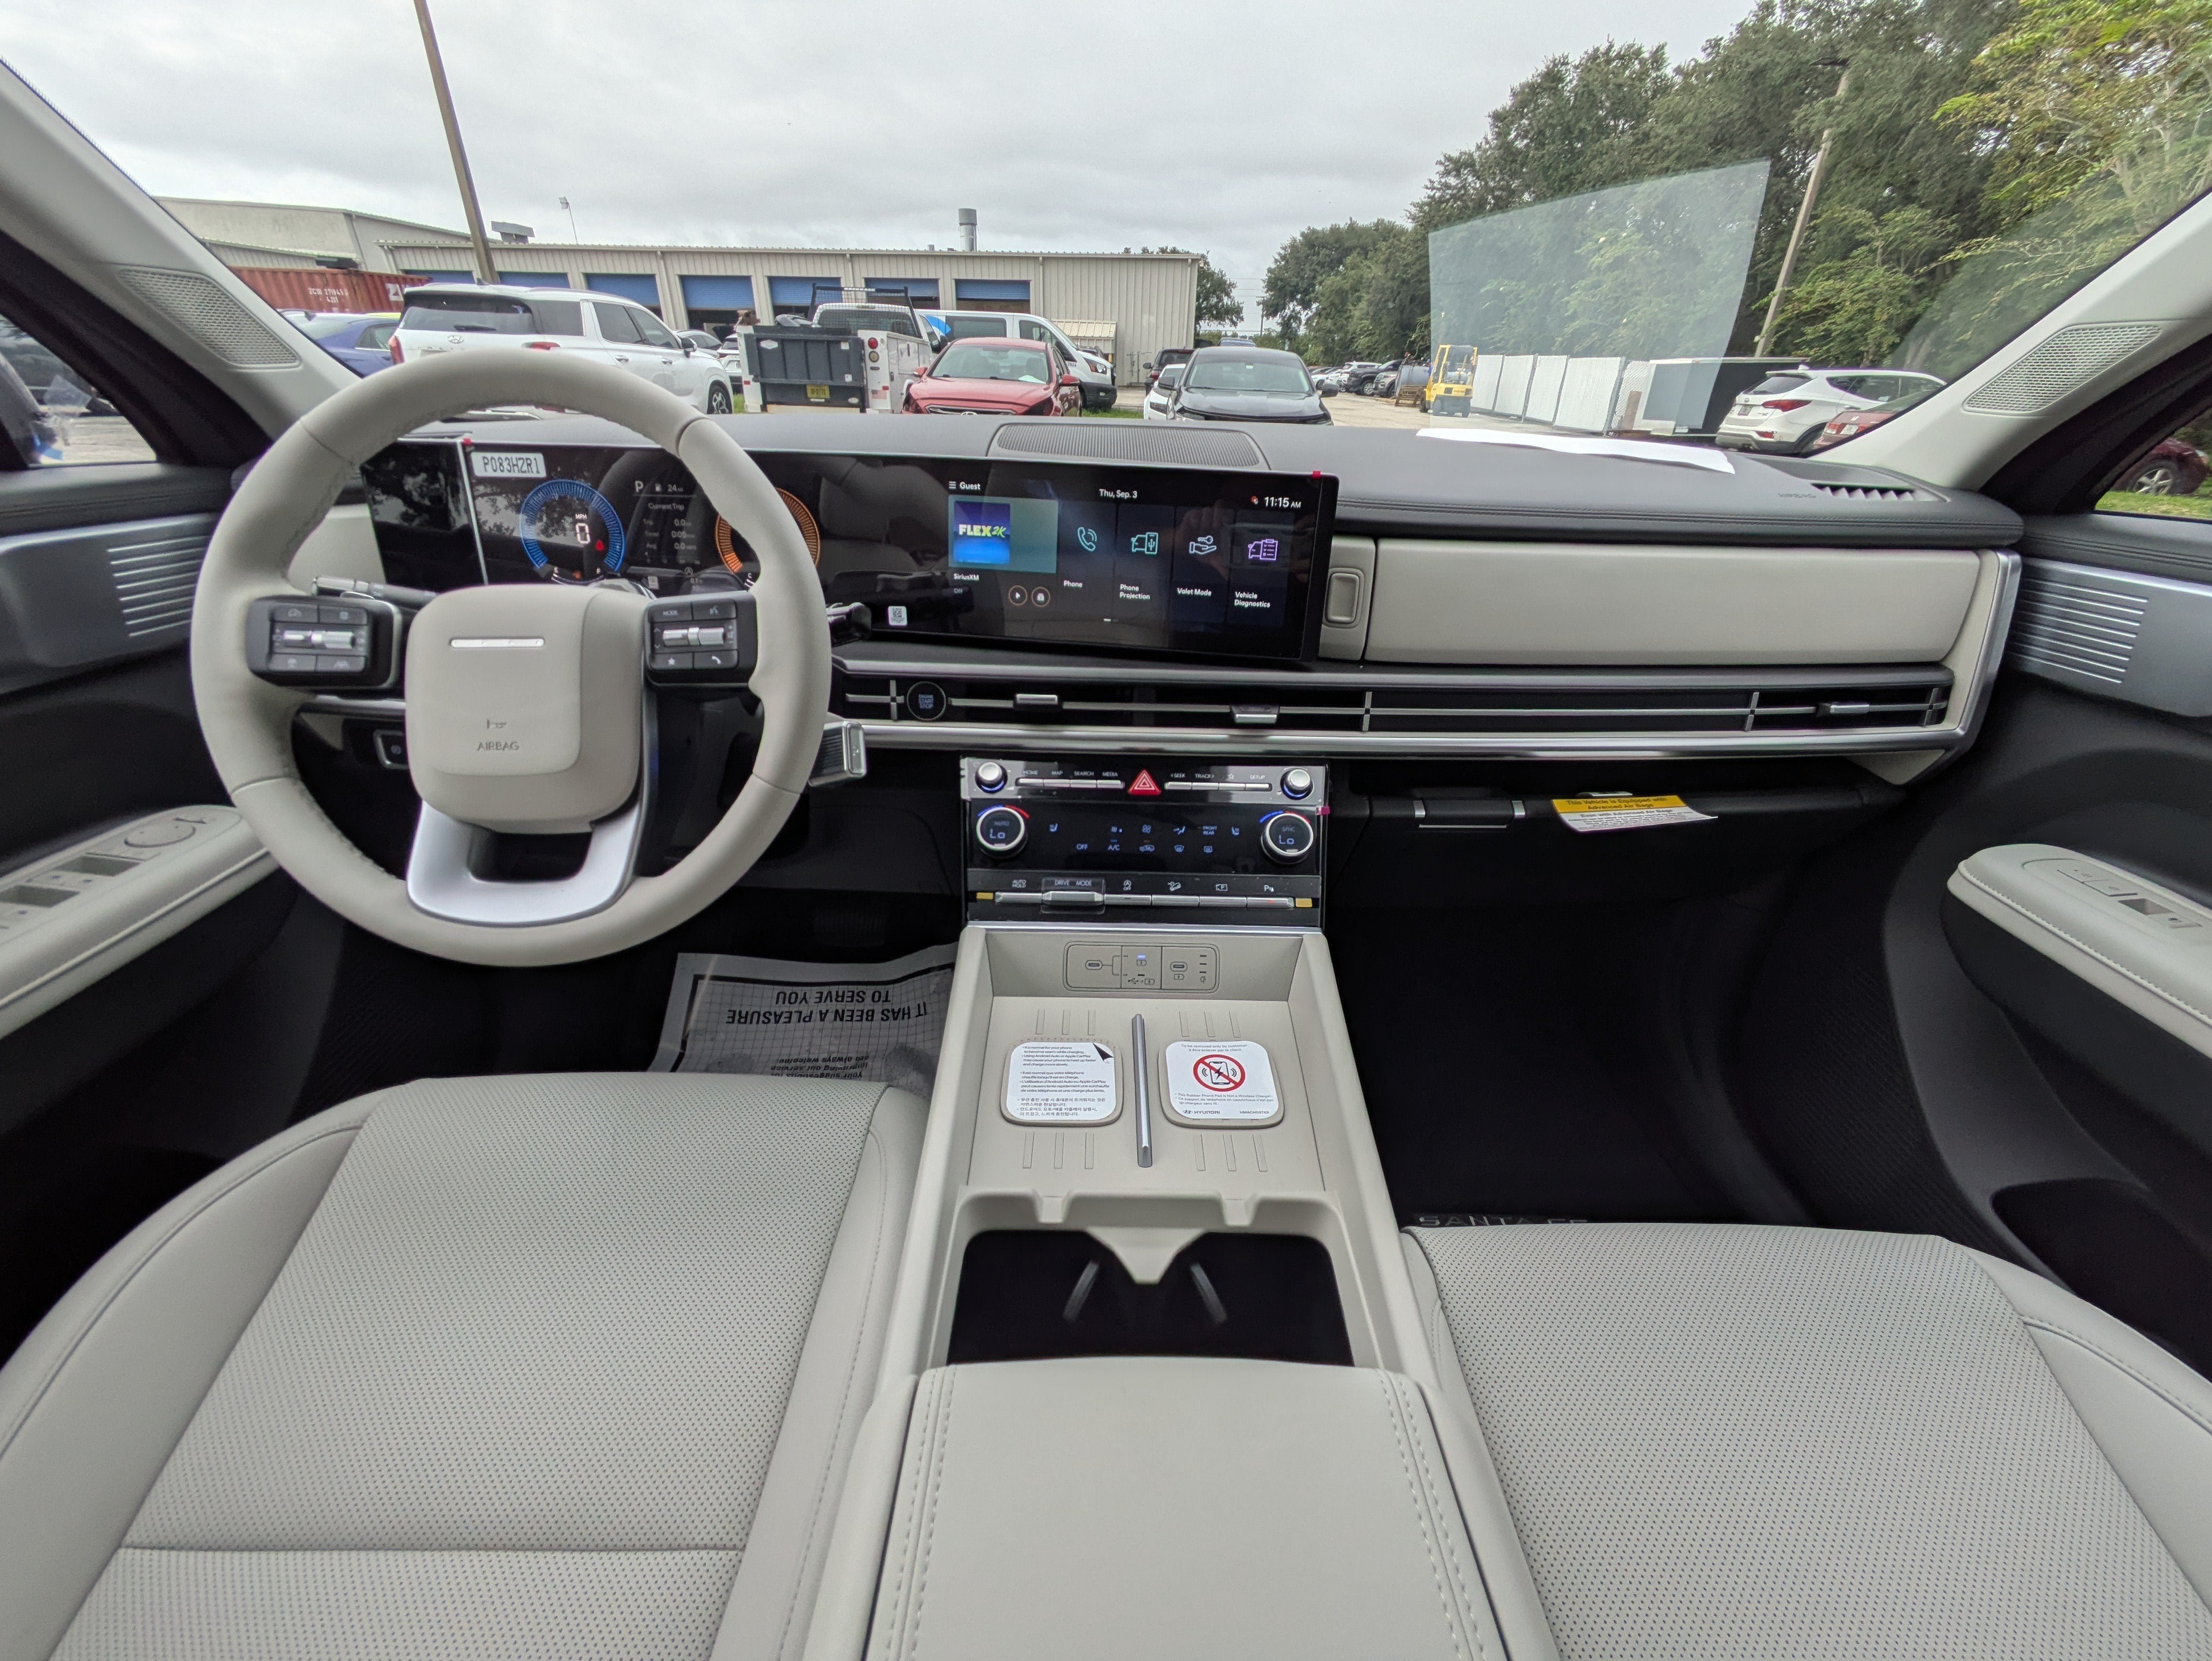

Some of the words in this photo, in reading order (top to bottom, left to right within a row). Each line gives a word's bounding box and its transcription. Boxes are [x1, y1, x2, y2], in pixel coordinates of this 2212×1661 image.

[482, 456, 540, 474] P083HZR1
[635, 480, 644, 493] P
[960, 482, 981, 491] Guest
[1099, 488, 1115, 498] Thu,
[1116, 490, 1131, 499] Sep.
[1132, 490, 1138, 498] 3
[1264, 497, 1289, 509] 11:15
[575, 522, 591, 544] 0
[1120, 584, 1139, 592] Phone
[1177, 587, 1193, 596] Valet
[1119, 592, 1150, 601] Projection
[1235, 591, 1258, 599] Vehicle
[1234, 599, 1271, 609] Diagnostics
[477, 741, 520, 752] AIRBAG
[775, 991, 809, 1005] YOU
[813, 990, 866, 1004] SERVE
[871, 989, 891, 1003] TO
[819, 1009, 829, 1022] A
[833, 1009, 875, 1022] BEEN
[880, 1005, 910, 1022] HAS
[915, 1001, 928, 1018] IT
[725, 1009, 813, 1025] PLEASURE
